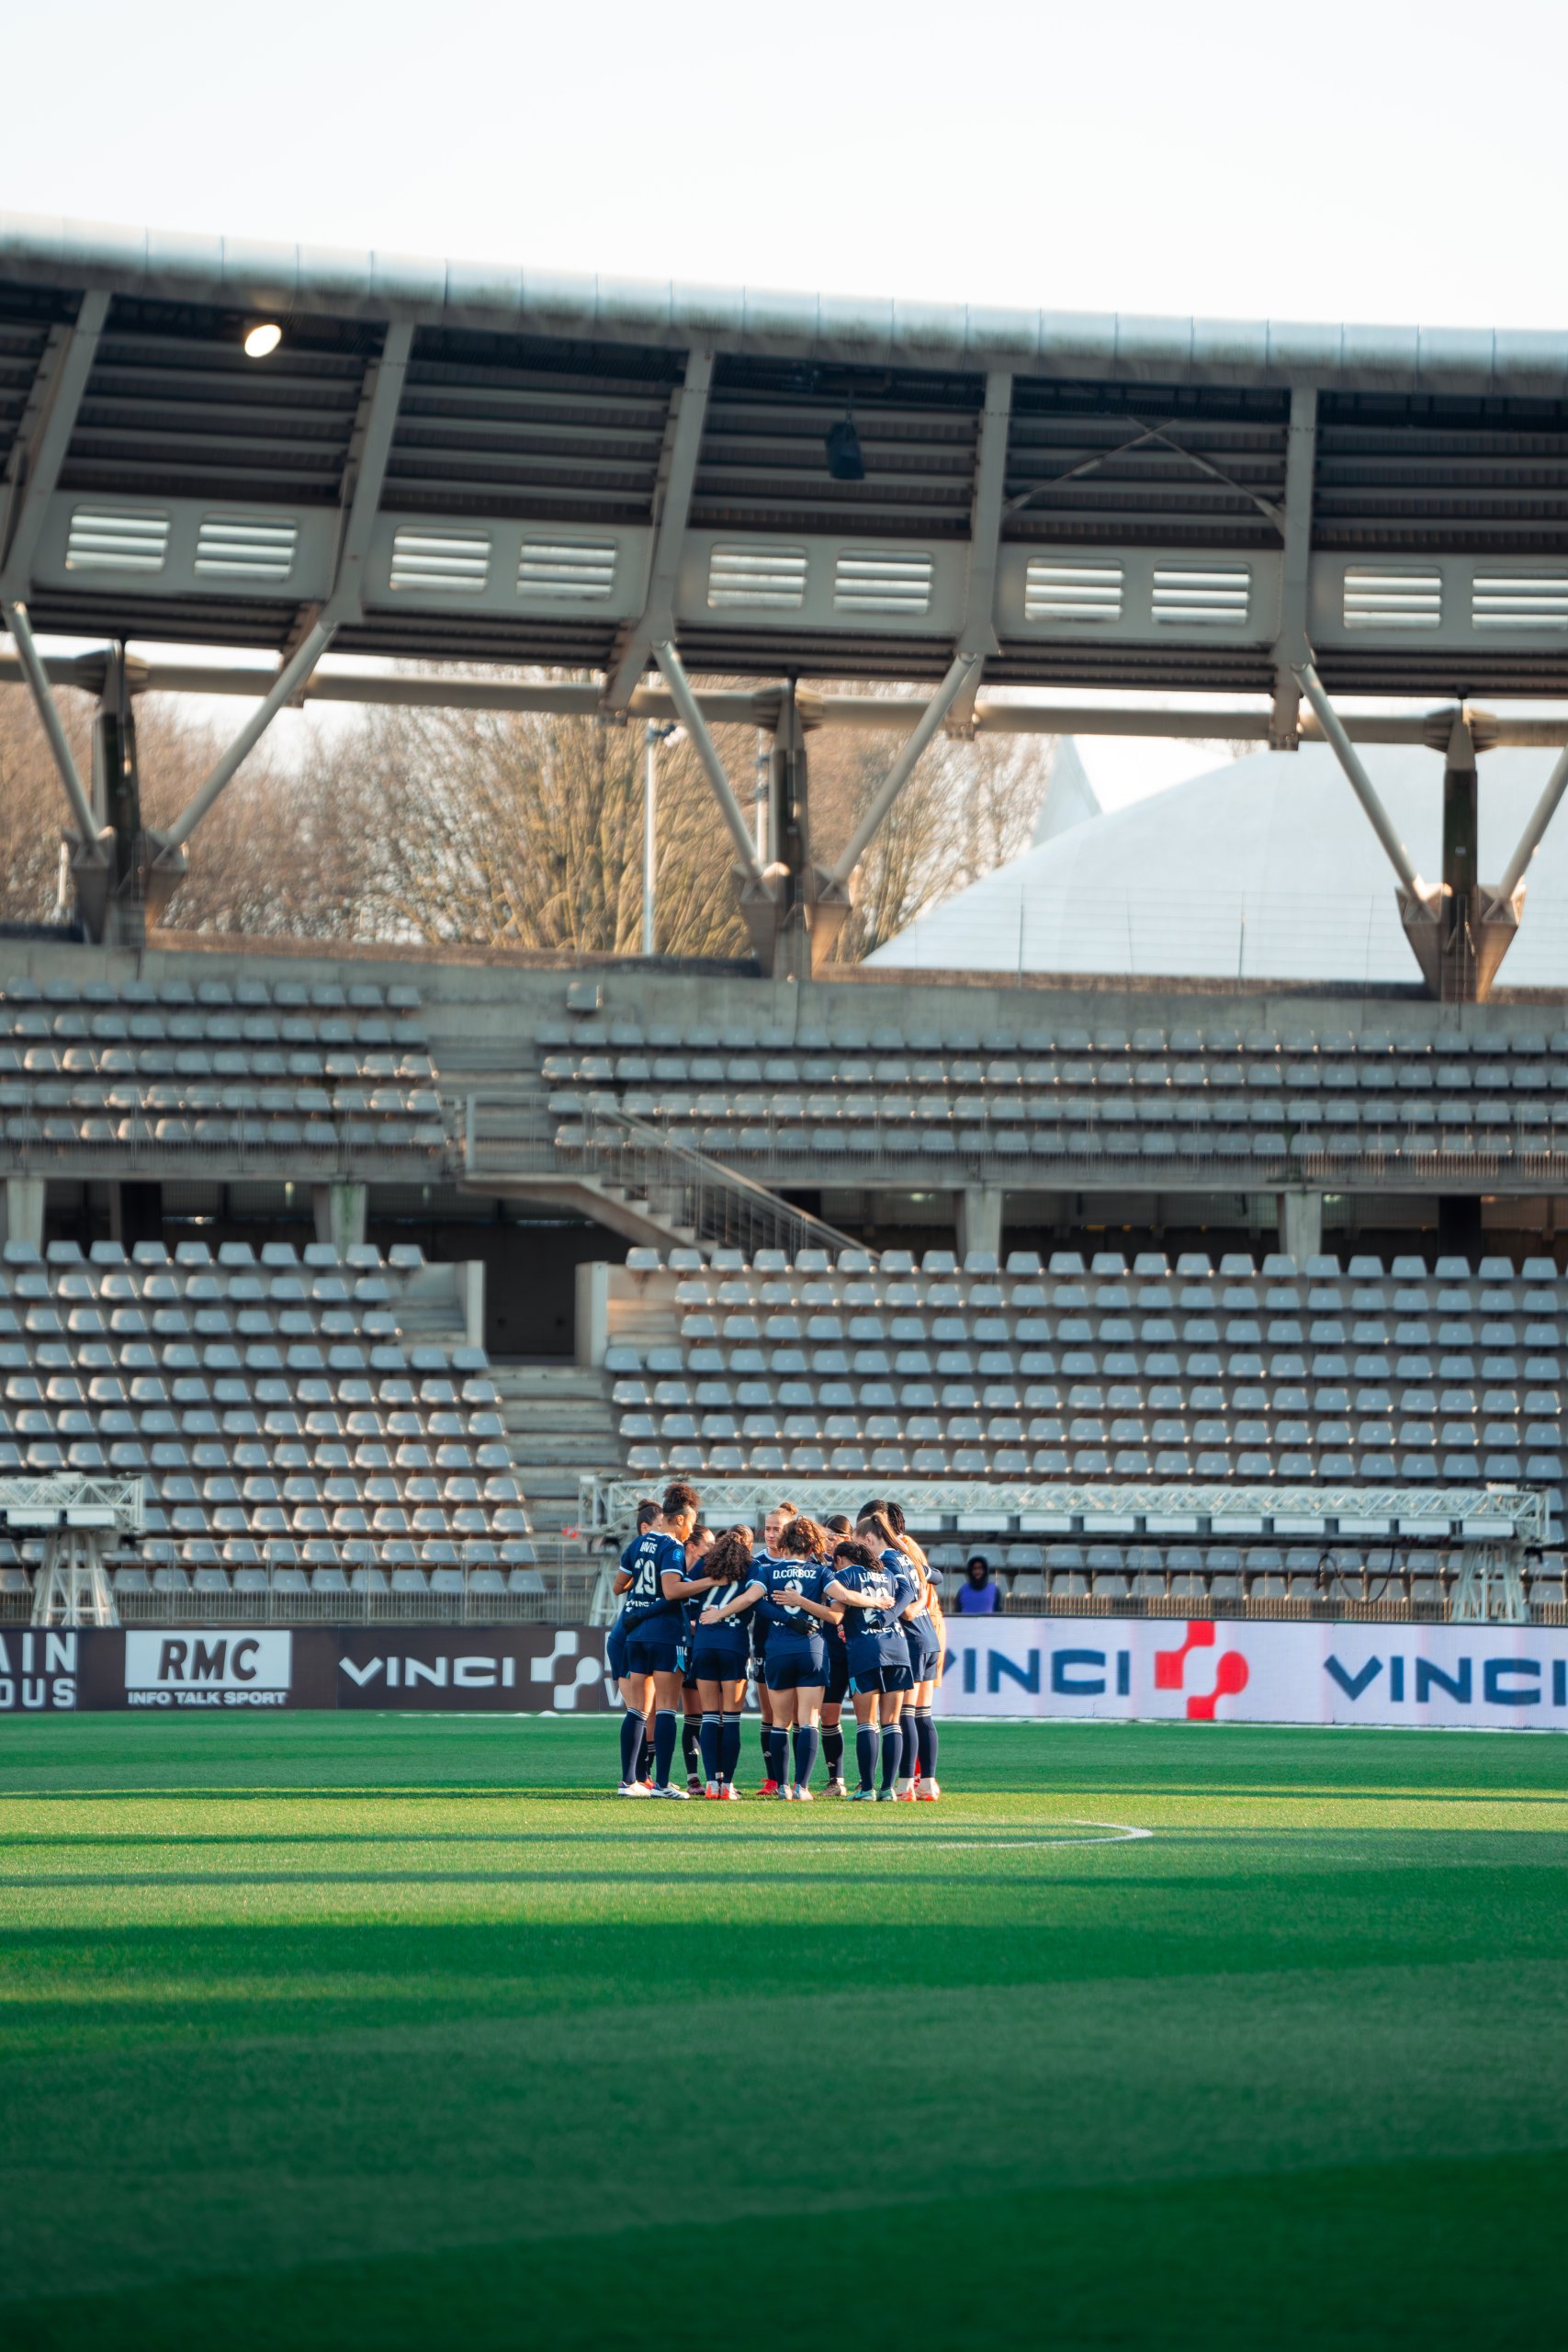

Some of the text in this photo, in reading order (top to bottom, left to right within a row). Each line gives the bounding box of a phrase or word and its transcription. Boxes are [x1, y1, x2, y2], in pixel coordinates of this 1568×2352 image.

[634, 1557, 657, 1595] 29
[773, 1569, 817, 1579] D.CORBOZ
[157, 1637, 260, 1681] RMC
[339, 1656, 515, 1688] VINCI
[128, 1691, 287, 1705] INFO TALK SPORT
[1323, 1654, 1567, 1707] VINCI
